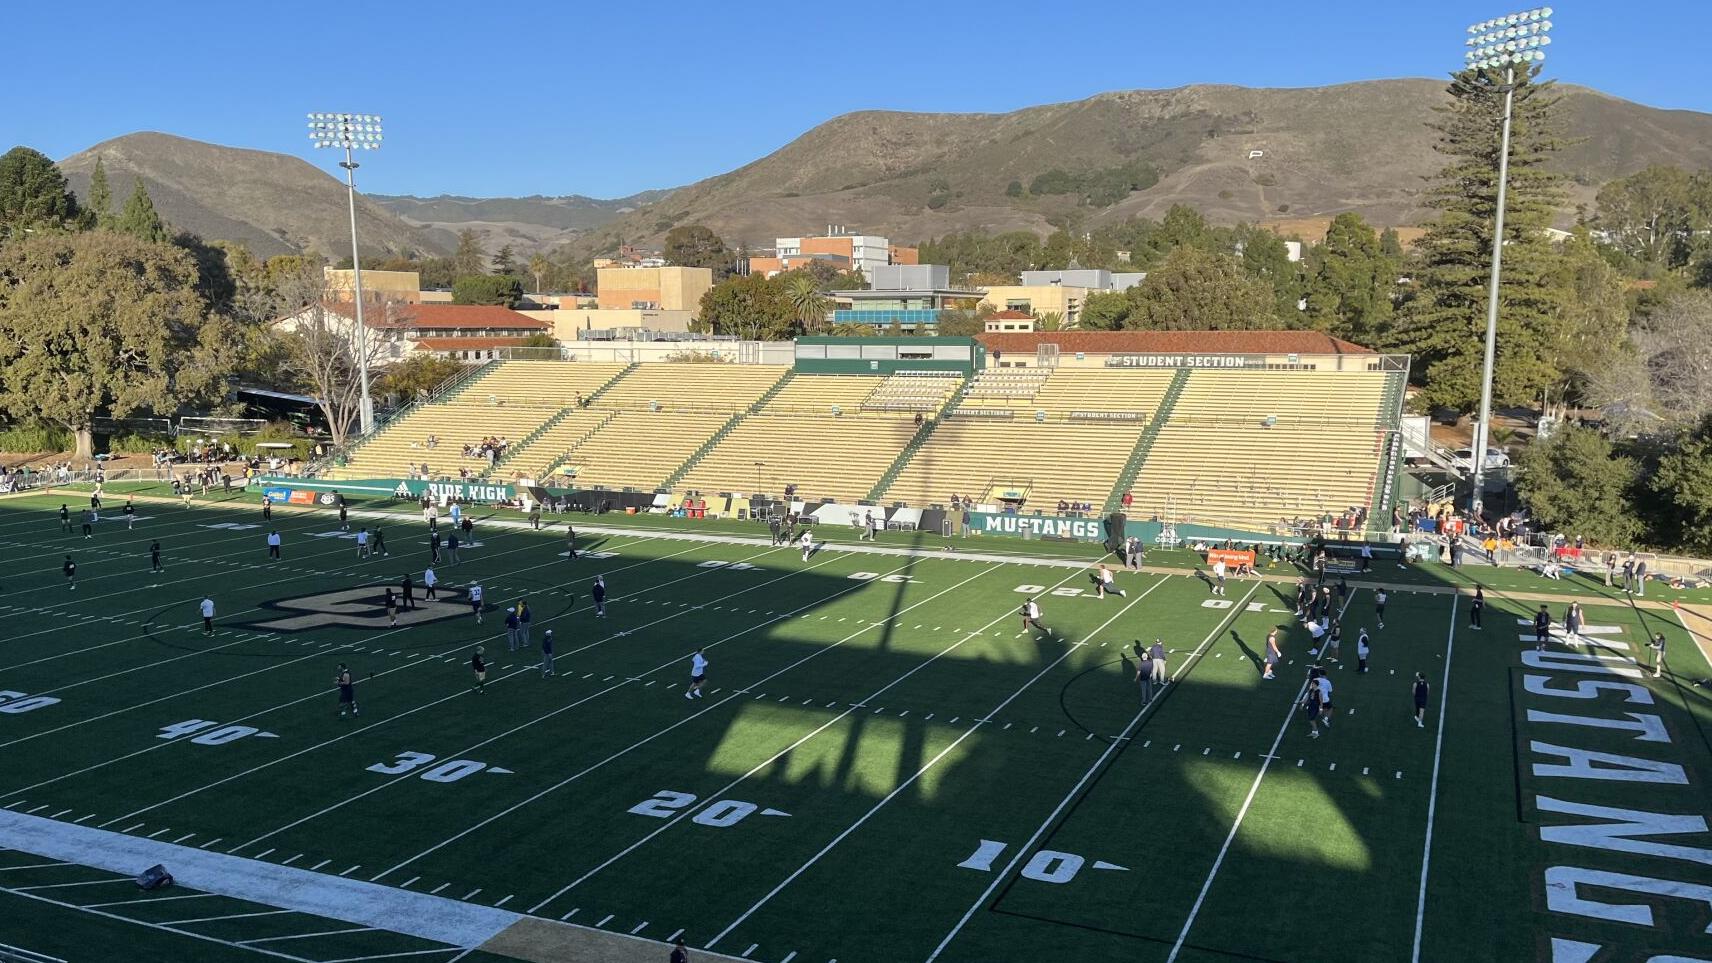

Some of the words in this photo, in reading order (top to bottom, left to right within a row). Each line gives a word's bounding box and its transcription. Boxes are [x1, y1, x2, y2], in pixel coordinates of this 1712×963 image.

[1123, 356, 1183, 367] STUDENT
[1186, 356, 1245, 367] SECTION
[428, 483, 464, 499] RIDE
[468, 485, 507, 501] HIGH
[985, 516, 1099, 538] MUSTANGS
[156, 719, 260, 746] 40
[366, 751, 487, 783] 30
[627, 790, 758, 828] 20
[957, 839, 1085, 884] 10
